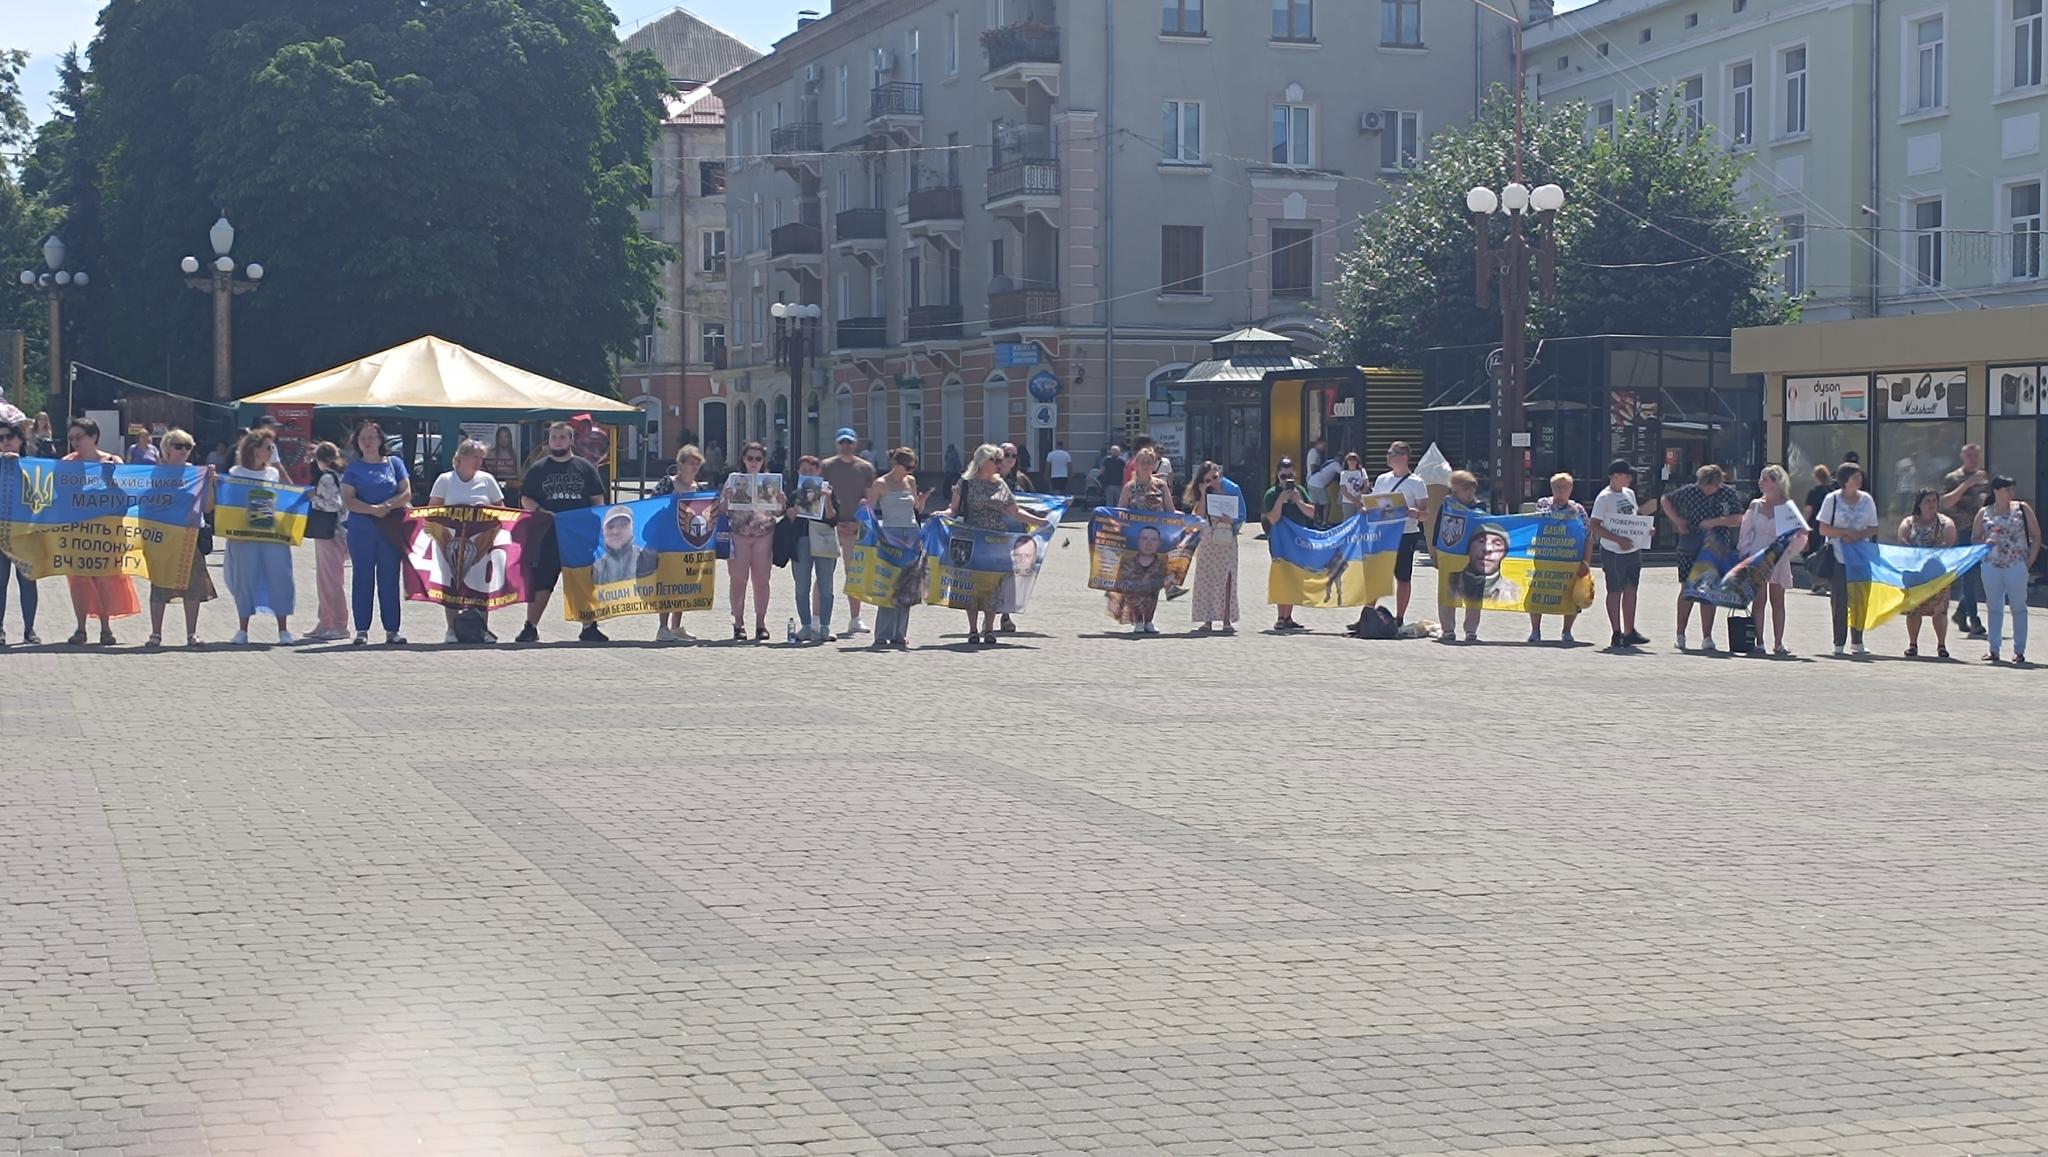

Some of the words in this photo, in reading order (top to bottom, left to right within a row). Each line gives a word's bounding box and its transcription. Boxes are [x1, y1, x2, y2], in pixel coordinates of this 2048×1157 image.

[1813, 380, 1841, 396] dyson
[1900, 402, 1938, 416] Marshall
[60, 474, 99, 487] ВОЛЮ
[72, 493, 173, 508] МАРІУПОЯ
[115, 524, 164, 544] ГЕРОЇВ
[58, 537, 67, 549] З
[53, 555, 73, 569] ВЧ
[78, 557, 109, 570] 3057
[114, 556, 141, 568] НГУ
[683, 553, 694, 564] 46
[611, 601, 649, 615] БЕЗВІСТИ
